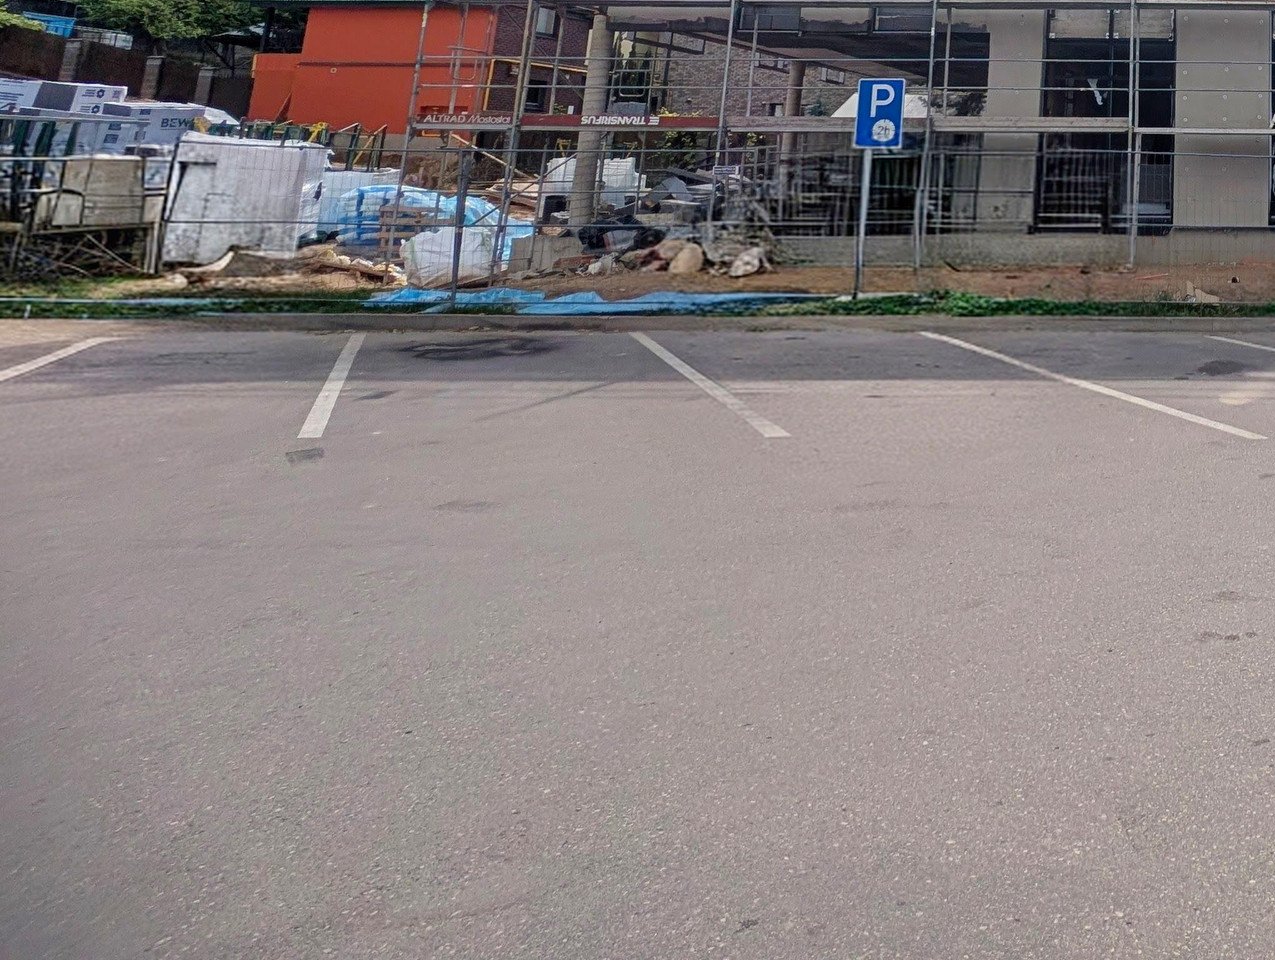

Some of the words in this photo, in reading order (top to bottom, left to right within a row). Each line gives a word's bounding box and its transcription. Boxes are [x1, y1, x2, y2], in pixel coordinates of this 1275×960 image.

[870, 84, 895, 118] P
[160, 117, 193, 128] BEW
[423, 114, 465, 123] ALTRAD
